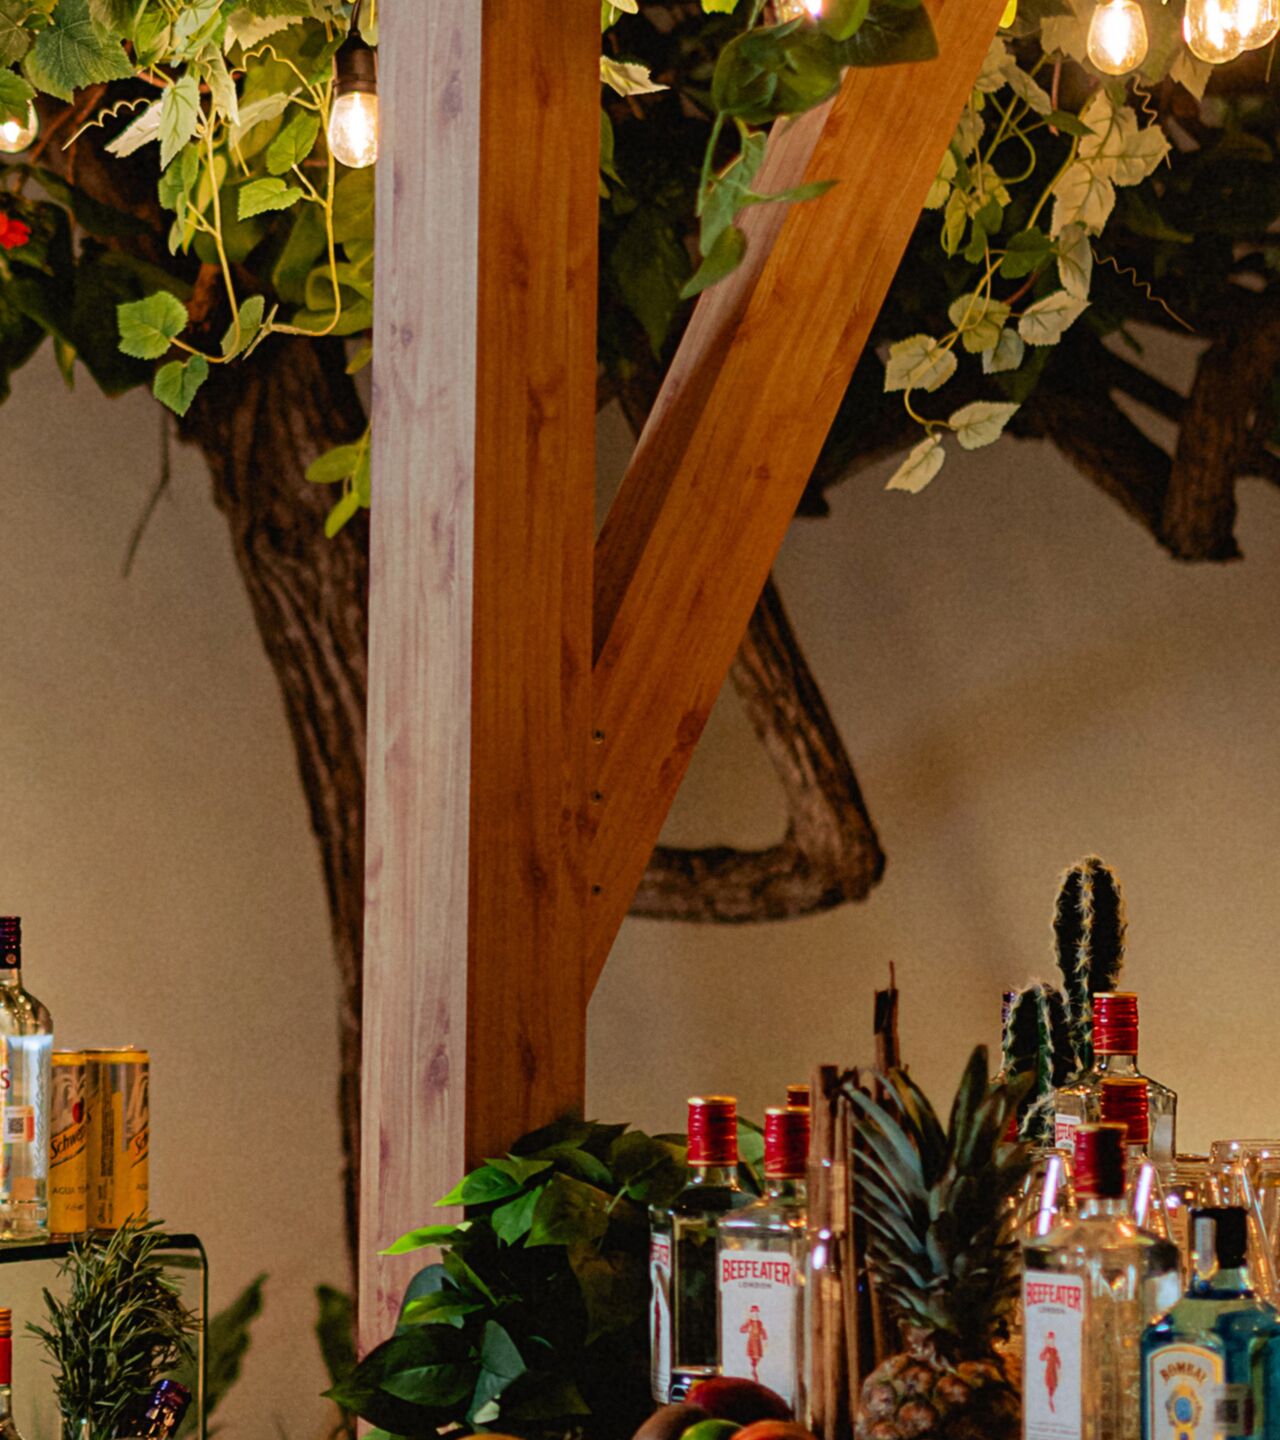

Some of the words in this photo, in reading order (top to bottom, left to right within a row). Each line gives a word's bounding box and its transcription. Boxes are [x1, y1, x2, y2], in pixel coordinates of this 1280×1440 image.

[722, 1259, 791, 1287] BEEFEATER
[1026, 1282, 1082, 1312] BEEFEATER
[1159, 1361, 1207, 1385] BOMBAY
